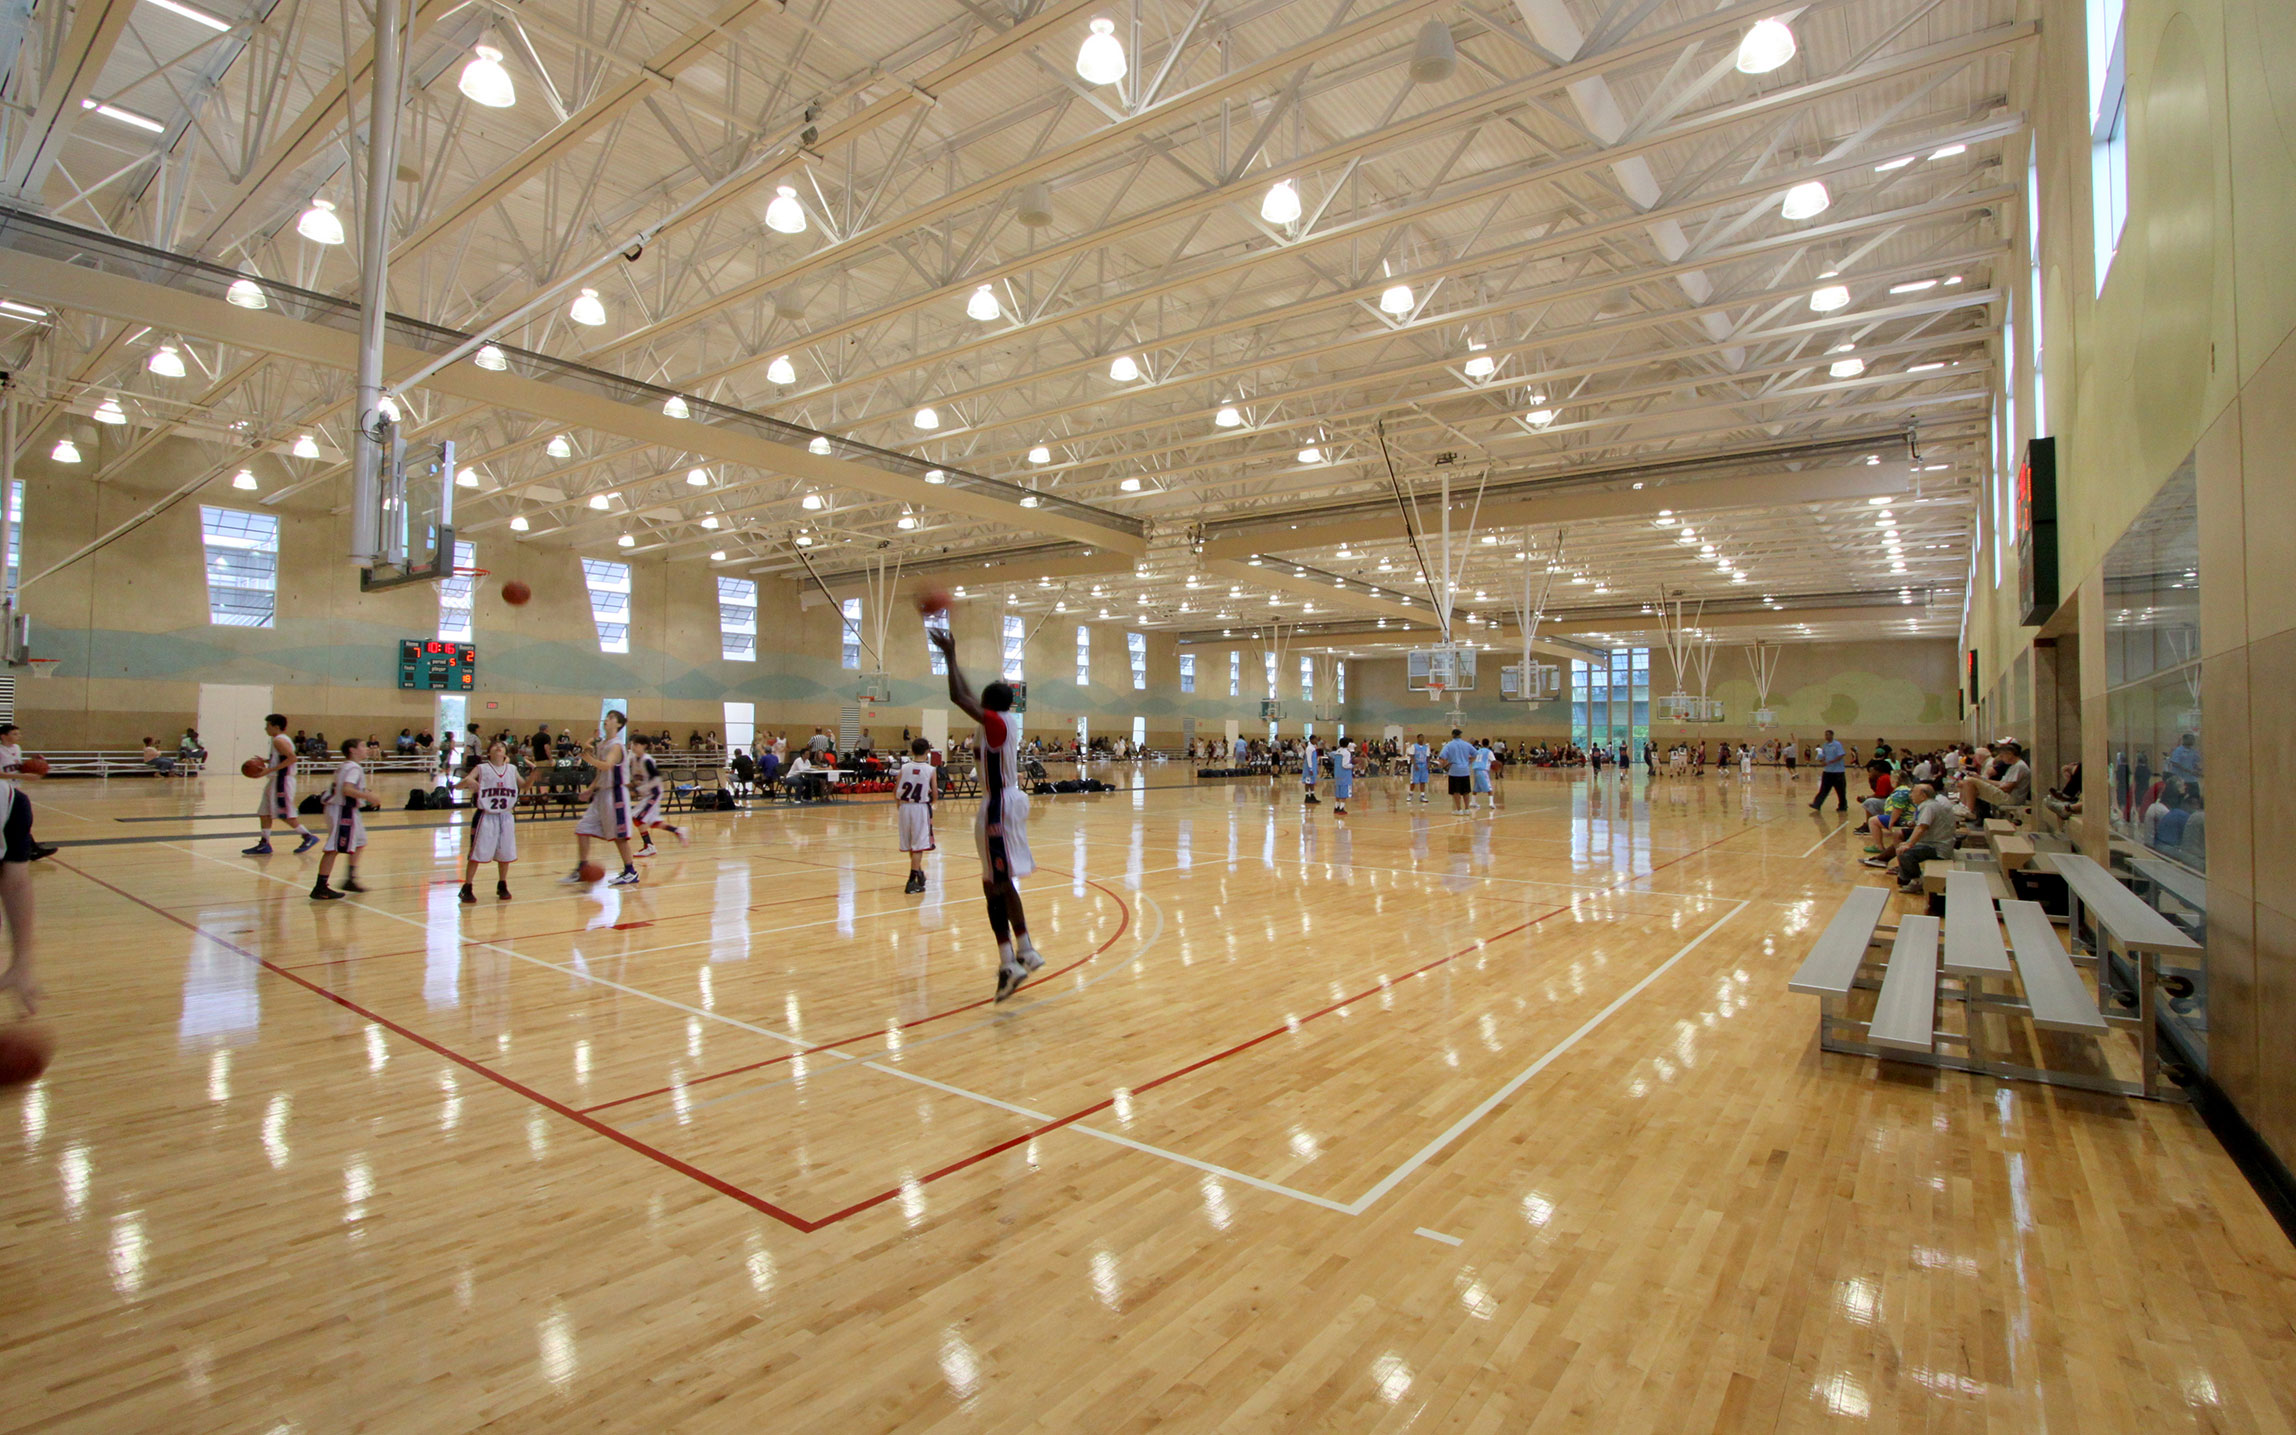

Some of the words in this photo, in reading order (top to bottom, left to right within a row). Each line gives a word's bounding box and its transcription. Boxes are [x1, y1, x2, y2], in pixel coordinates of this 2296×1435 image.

[414, 647, 421, 658] 7
[466, 650, 474, 662] 2
[481, 787, 517, 798] FINEST
[900, 782, 923, 802] 24
[490, 798, 508, 810] 23
